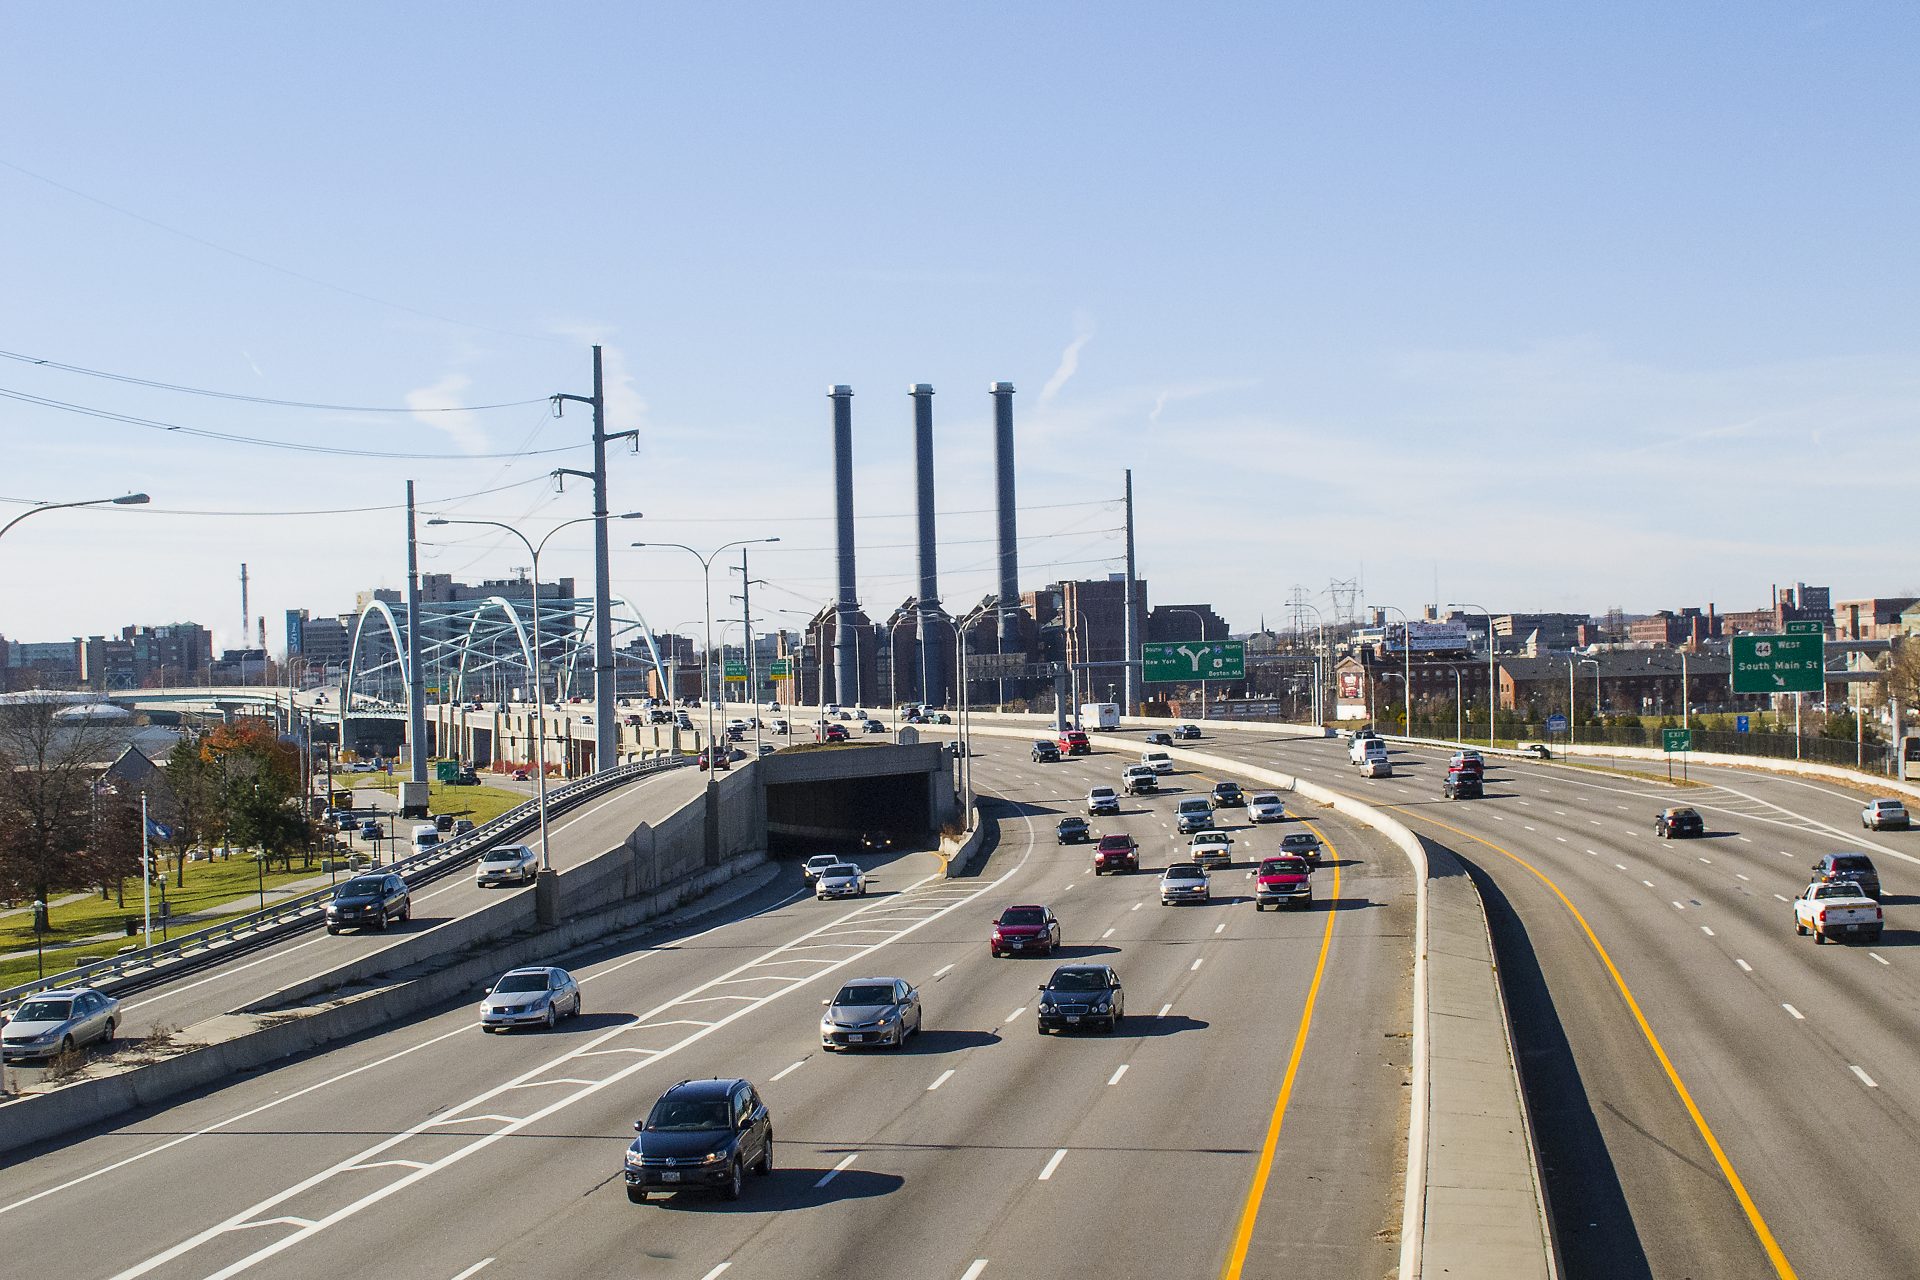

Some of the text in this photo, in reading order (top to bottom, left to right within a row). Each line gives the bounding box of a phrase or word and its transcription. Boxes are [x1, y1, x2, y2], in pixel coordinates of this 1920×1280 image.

[1756, 645, 1769, 653] 44
[1738, 660, 1818, 670] South Main St
[1670, 740, 1678, 748] 2
